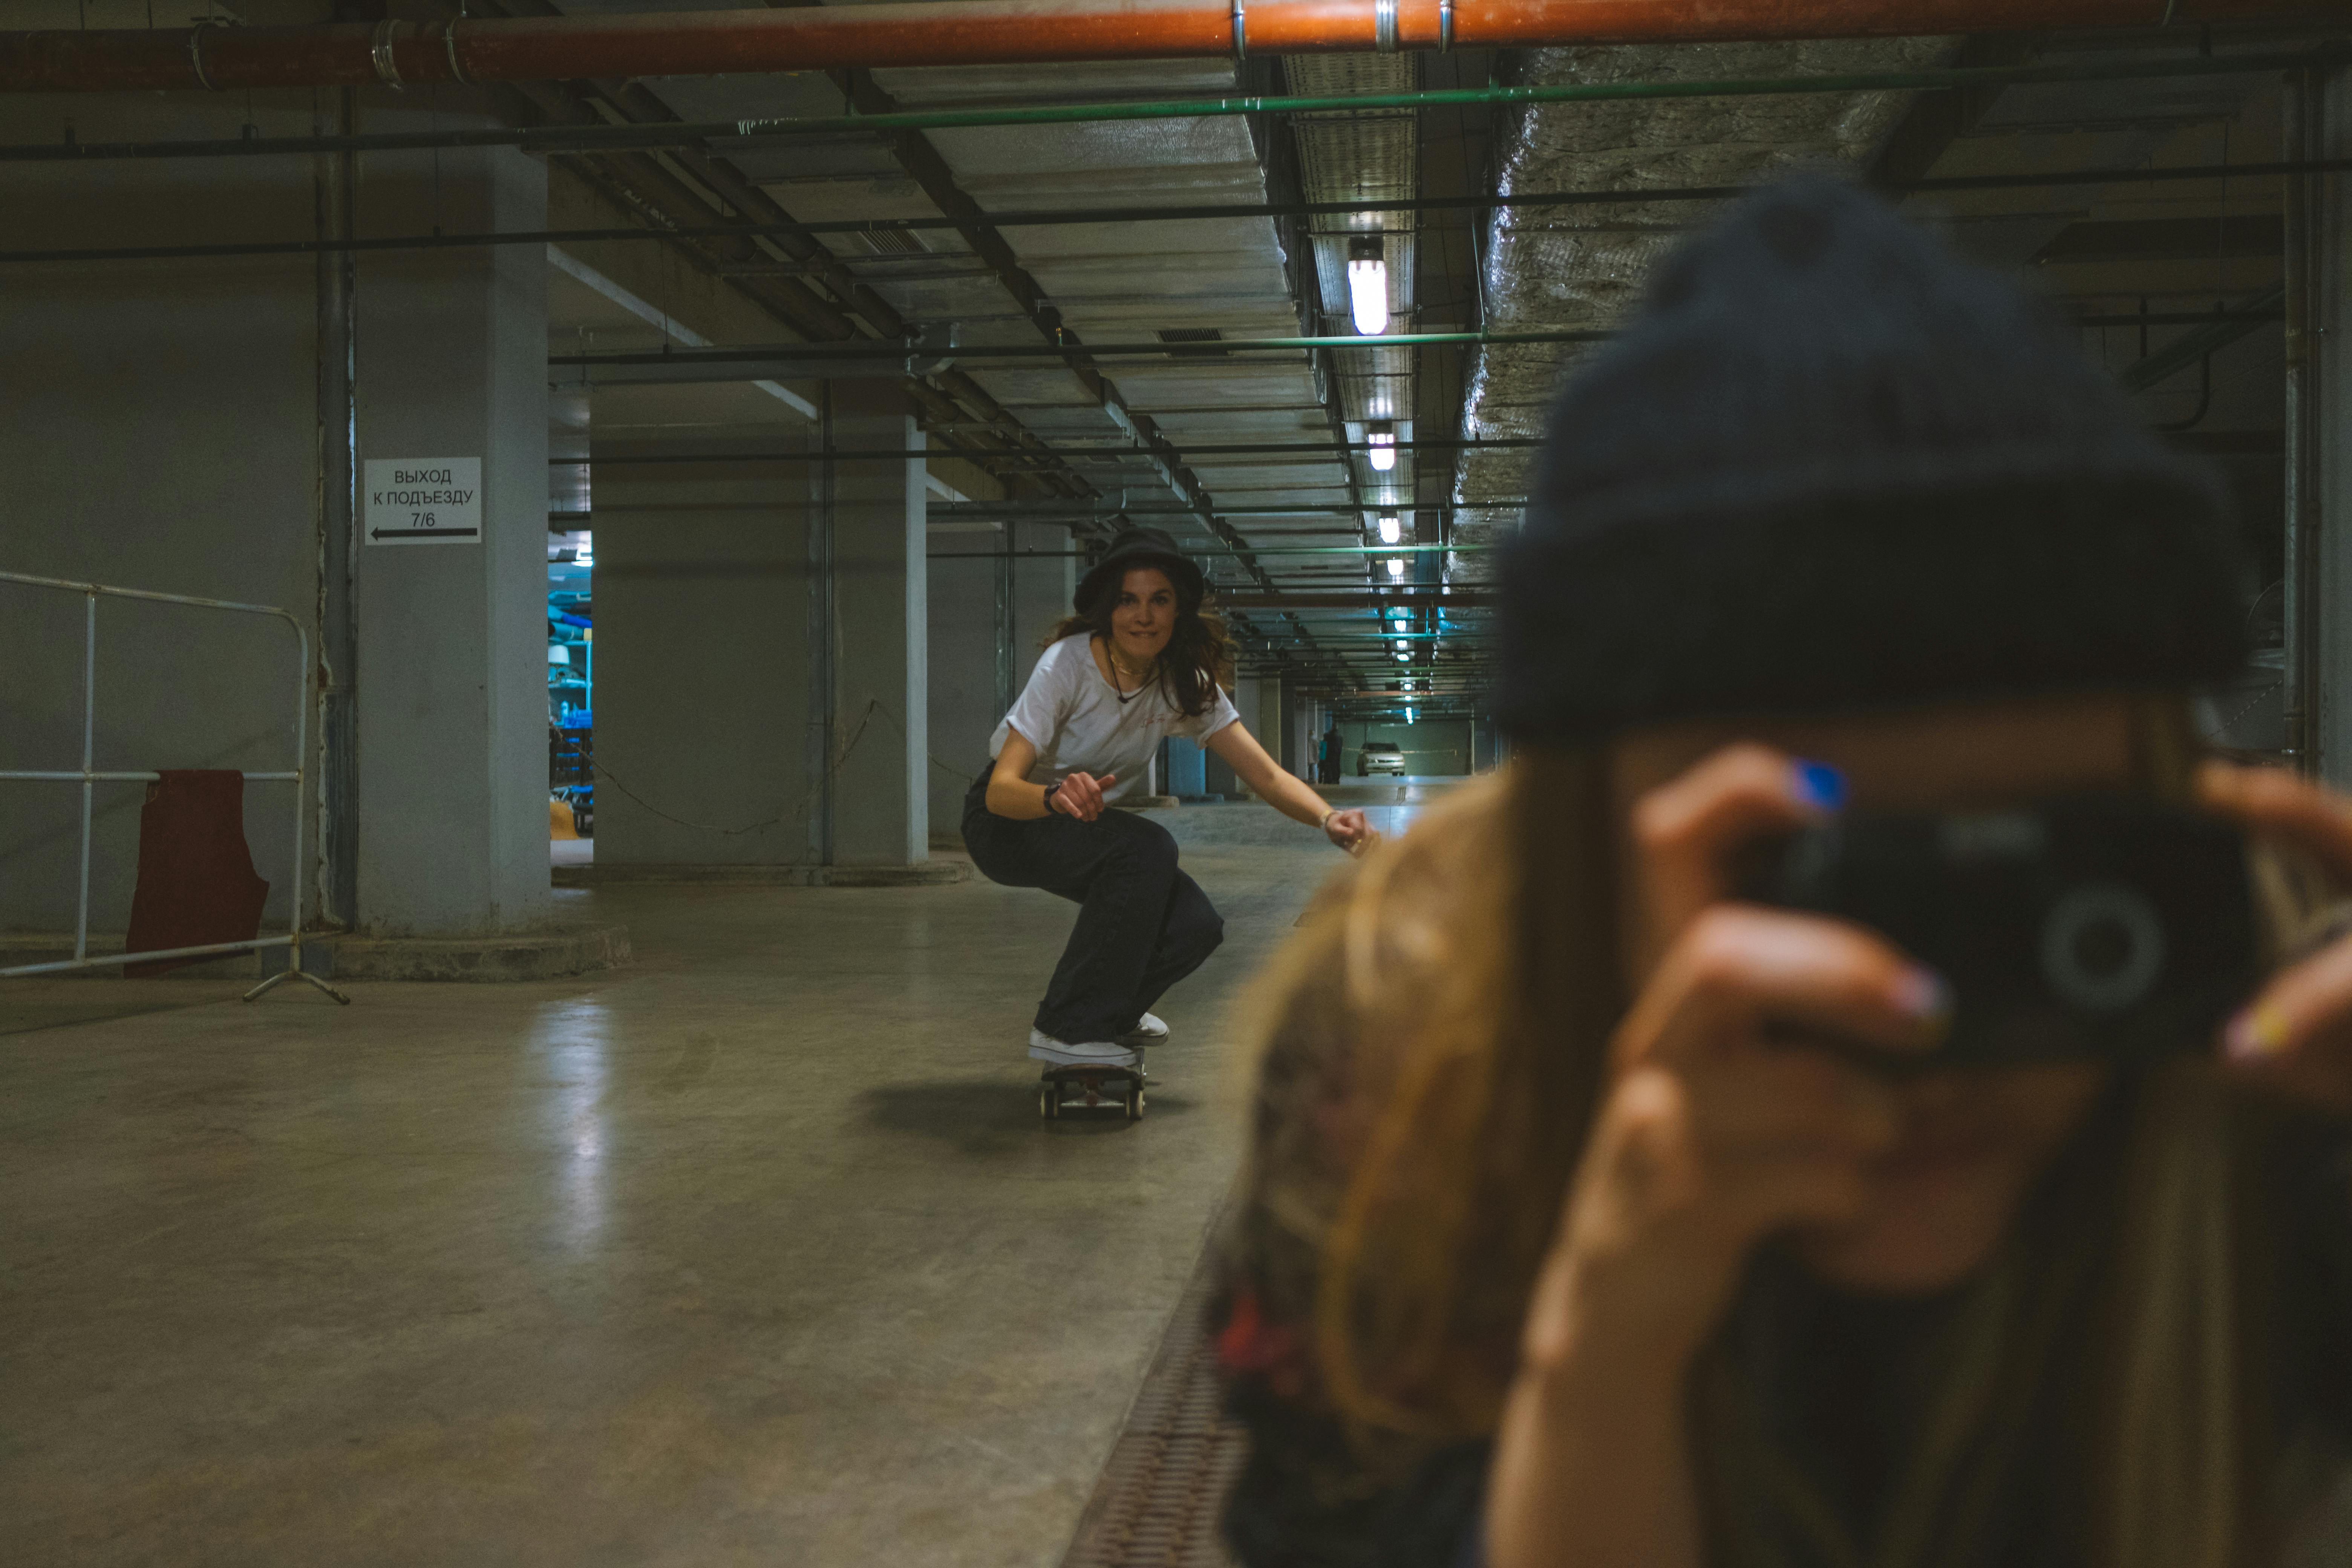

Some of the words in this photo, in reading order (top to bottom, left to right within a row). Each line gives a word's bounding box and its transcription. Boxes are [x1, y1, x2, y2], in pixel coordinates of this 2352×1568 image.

[395, 469, 451, 485] ВЫХОД
[374, 492, 382, 505] К
[387, 490, 473, 507] ПОДЪЕЗДУ
[411, 512, 435, 527] 7/6
